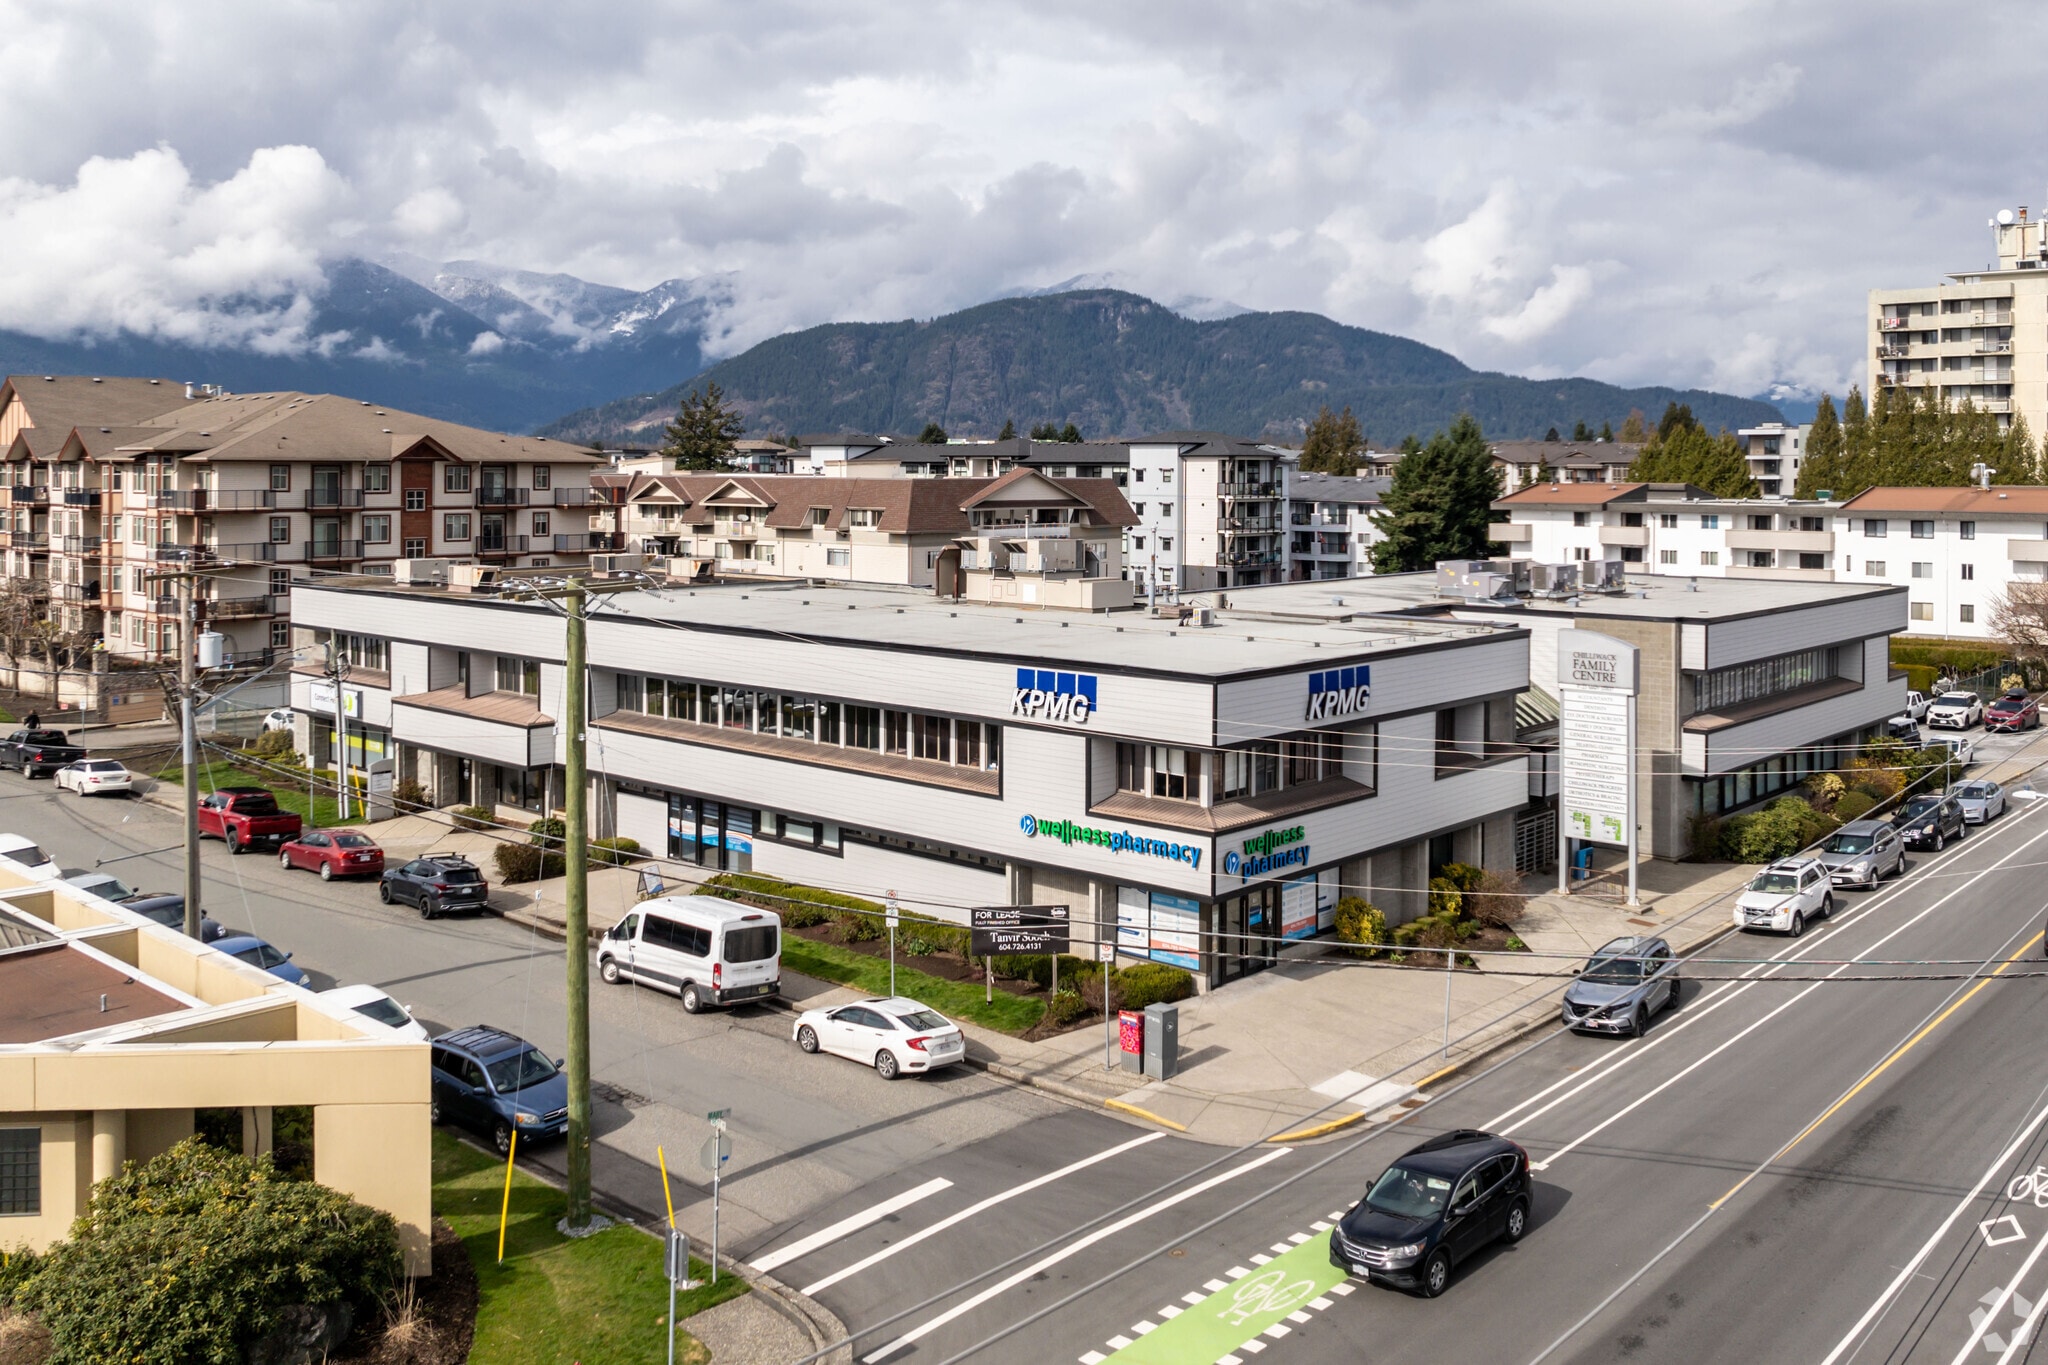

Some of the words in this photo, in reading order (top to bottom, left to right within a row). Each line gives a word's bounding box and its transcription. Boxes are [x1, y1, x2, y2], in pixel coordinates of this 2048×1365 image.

[1573, 652, 1616, 660] CHILLIWACK
[1573, 659, 1616, 672] FAMILY
[1573, 670, 1616, 683] CENTRE
[1009, 688, 1088, 722] KPMG
[1309, 685, 1370, 720] KPMG
[1244, 825, 1305, 856] wellness
[1242, 845, 1310, 884] pharmacy
[975, 911, 992, 919] FOR
[990, 932, 1020, 942] Tanvir
[998, 943, 1042, 951] 604.726.4131
